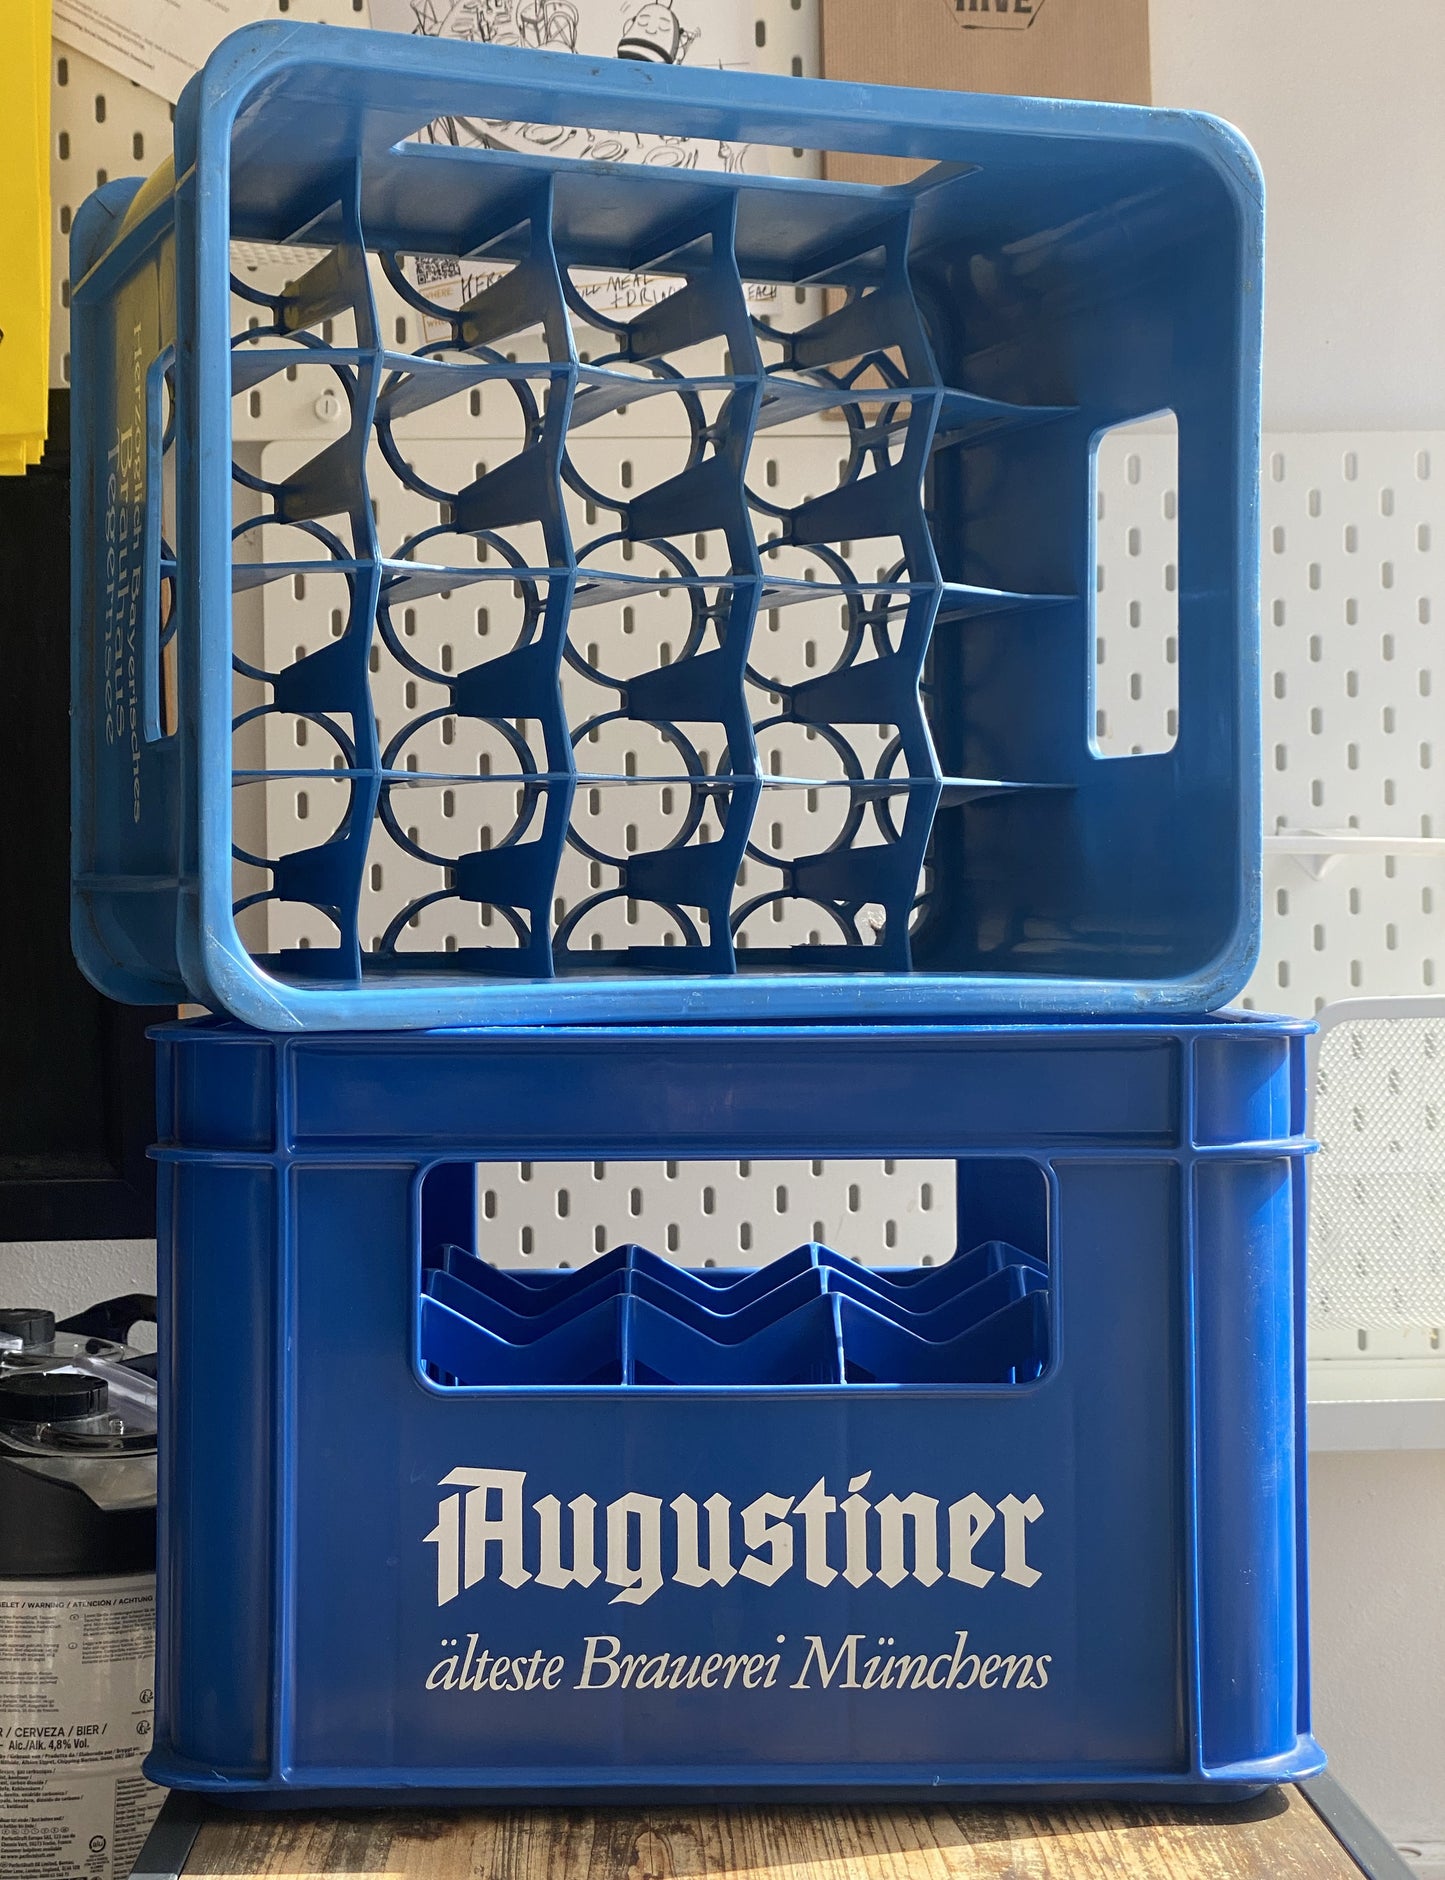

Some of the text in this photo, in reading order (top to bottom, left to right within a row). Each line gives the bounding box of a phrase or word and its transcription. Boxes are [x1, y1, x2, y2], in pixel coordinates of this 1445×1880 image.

[748, 283, 777, 299] EACH
[104, 426, 121, 746] Tegernsee
[114, 424, 134, 737] Brauhaus
[127, 320, 143, 824] Herzoglich Bayerisches
[422, 1466, 1045, 1607] Augustiner
[27, 1601, 65, 1609] WARNING
[118, 1594, 154, 1605] ACHTUNG
[425, 1630, 1053, 1690] älteste Brauerei Münchens
[15, 1726, 65, 1738] CERVEZA
[76, 1724, 99, 1736] BIER
[48, 1739, 72, 1751] 4,8%
[73, 1738, 90, 1749] Vol.
